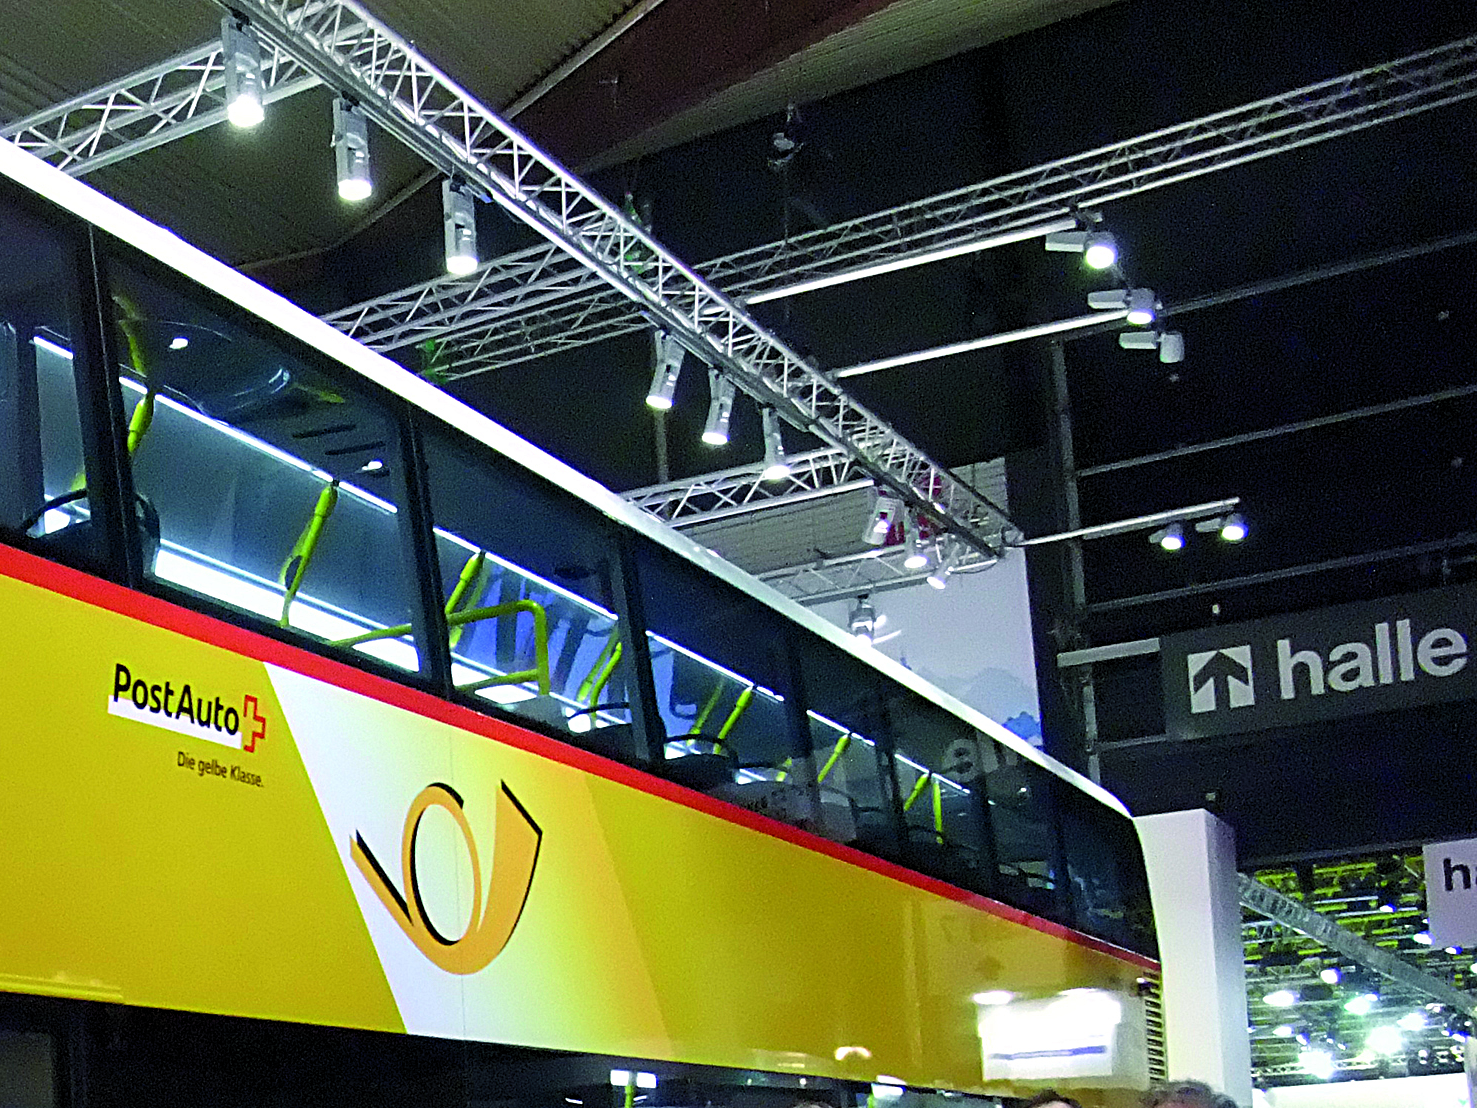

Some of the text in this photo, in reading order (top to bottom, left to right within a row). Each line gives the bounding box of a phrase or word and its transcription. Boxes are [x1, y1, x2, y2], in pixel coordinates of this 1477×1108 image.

[1277, 618, 1468, 700] halle
[114, 663, 239, 735] PostAuto
[177, 751, 264, 788] Die gelbe Klasse.
[1443, 857, 1477, 891] h
